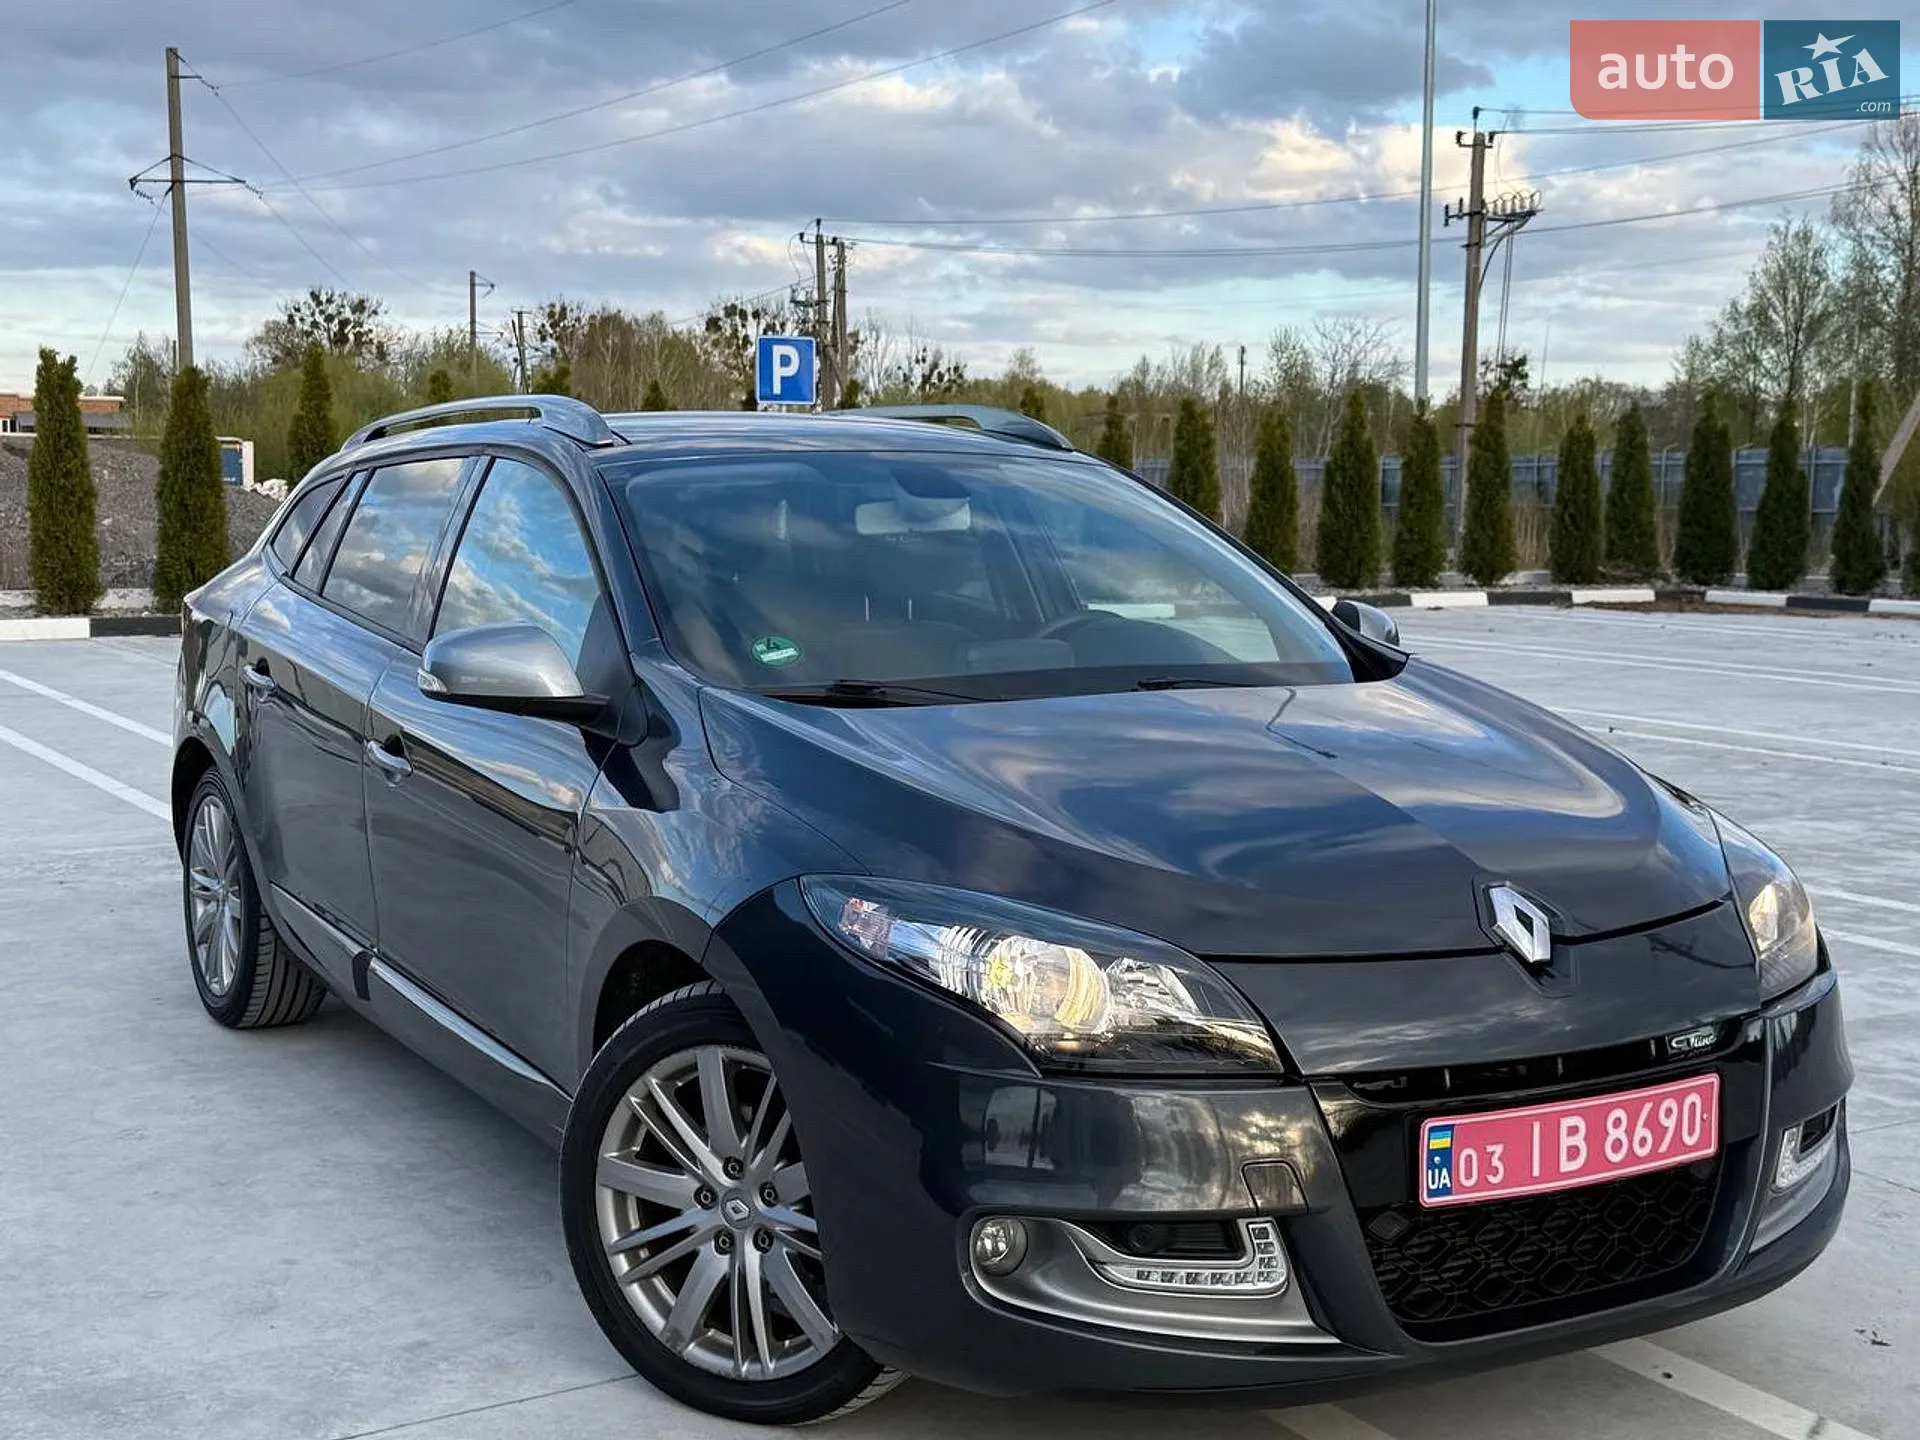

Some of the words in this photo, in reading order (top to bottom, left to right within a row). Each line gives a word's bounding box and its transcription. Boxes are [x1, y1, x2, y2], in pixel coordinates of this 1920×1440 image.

[772, 344, 800, 395] P
[1459, 1144, 1504, 1187] 03
[1532, 1116, 1587, 1177] IB
[1605, 1092, 1701, 1163] 8690
[1428, 1168, 1451, 1190] UA
